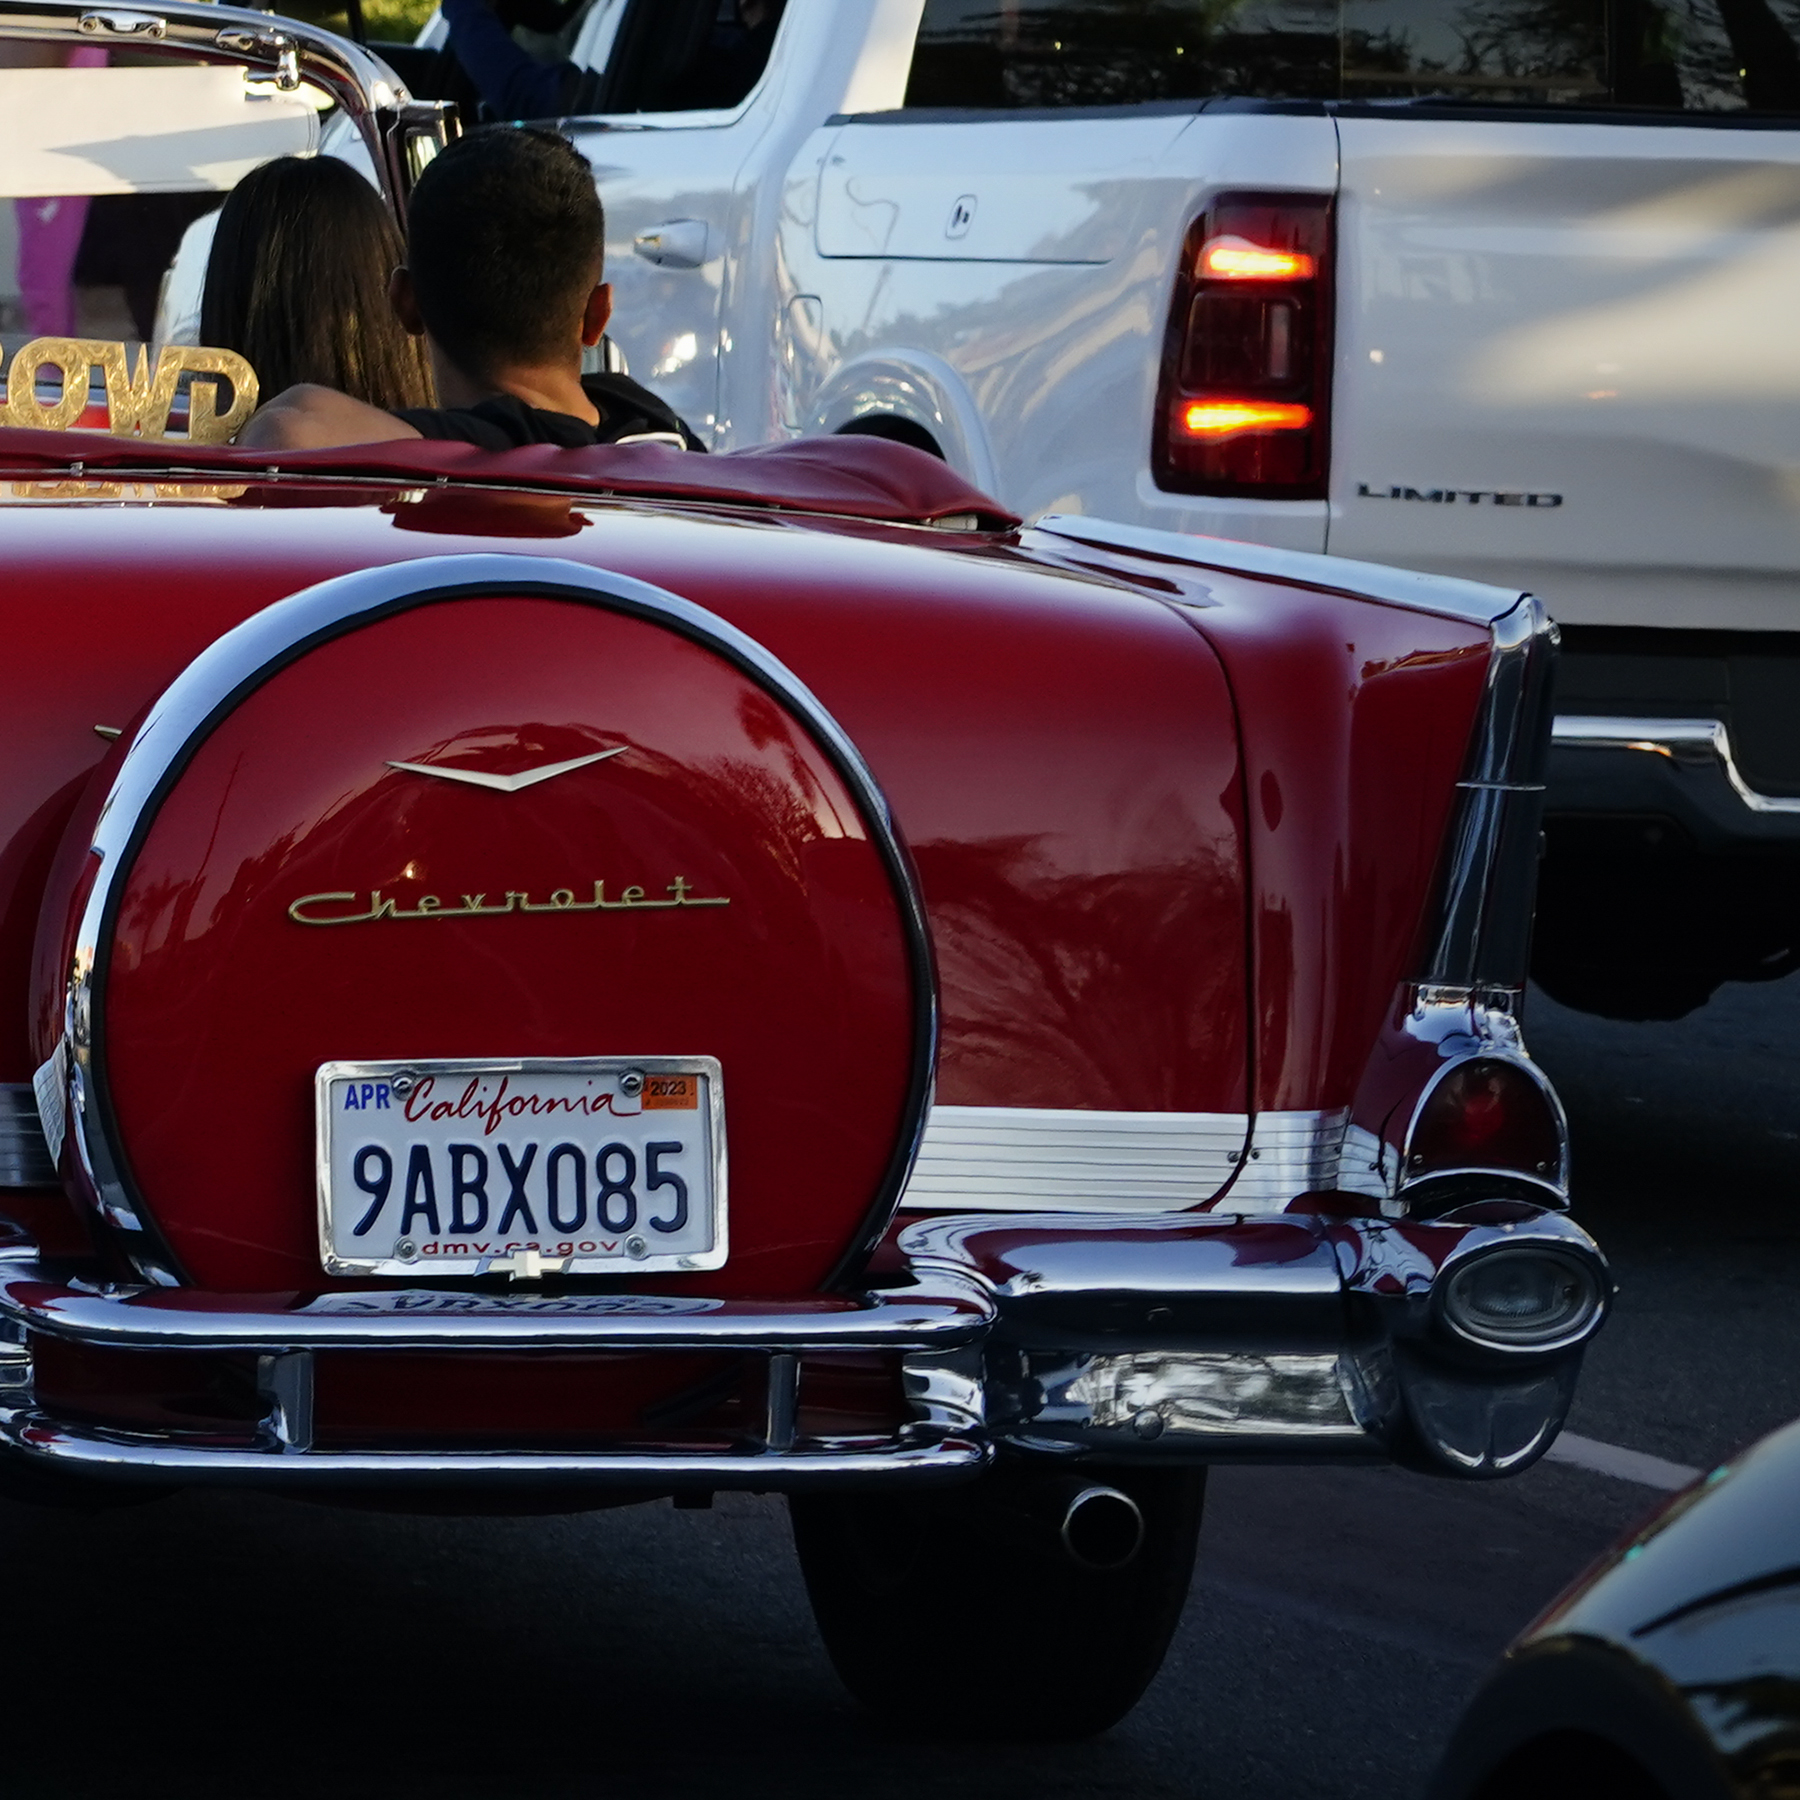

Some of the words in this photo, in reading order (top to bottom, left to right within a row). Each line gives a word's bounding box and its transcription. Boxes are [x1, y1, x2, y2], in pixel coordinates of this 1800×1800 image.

[1357, 481, 1564, 507] LIMITED
[288, 875, 732, 926] Chevrolet
[343, 1083, 391, 1111] APR
[403, 1075, 643, 1136] California
[650, 1080, 687, 1097] 2023
[352, 1140, 689, 1237] 9ABX085
